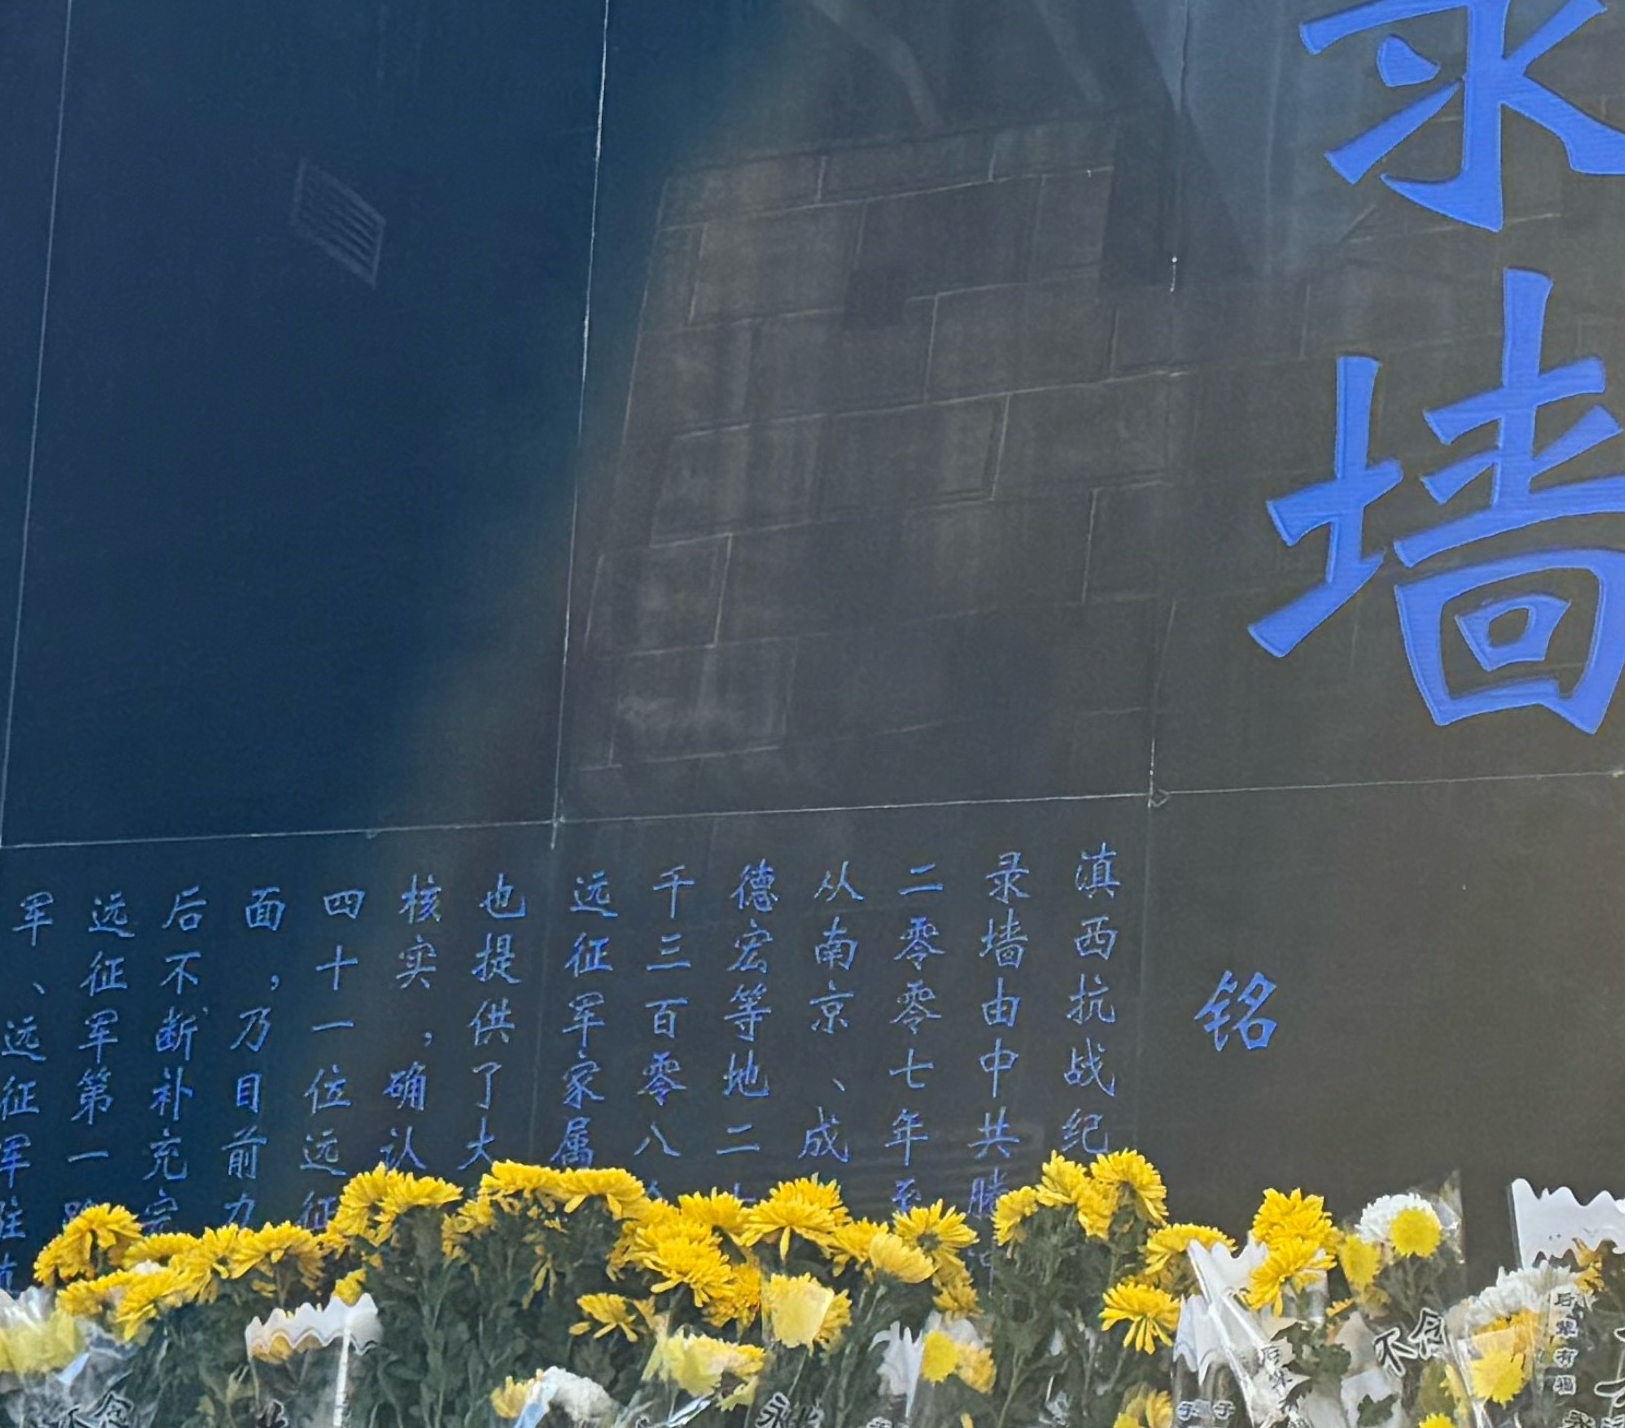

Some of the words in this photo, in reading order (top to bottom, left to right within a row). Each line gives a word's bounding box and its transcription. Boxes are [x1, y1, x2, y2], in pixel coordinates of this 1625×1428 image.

[457, 873, 527, 1171] 也提供了大
[550, 869, 619, 1167] 远征军家属
[1061, 842, 1122, 1156] 滇西抗战纪
[1193, 969, 1280, 1052] 铭
